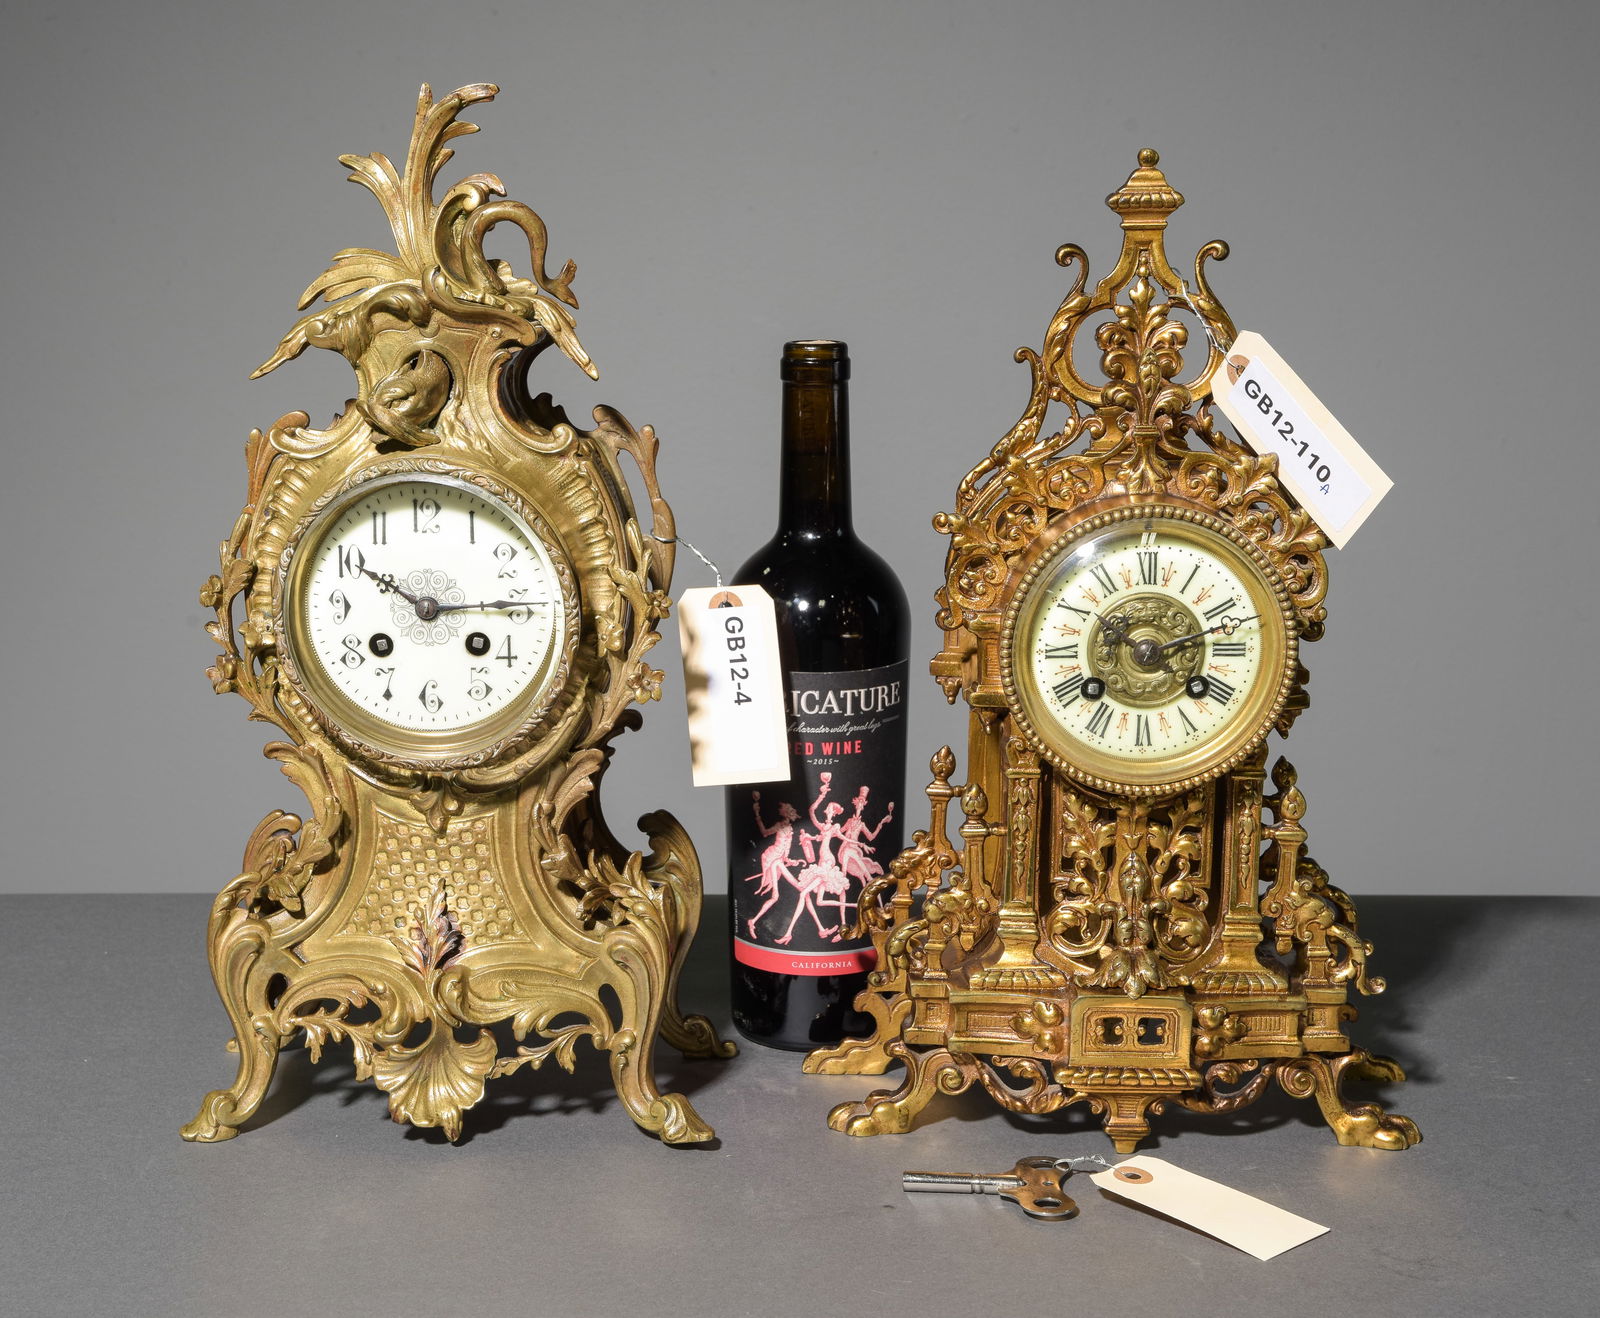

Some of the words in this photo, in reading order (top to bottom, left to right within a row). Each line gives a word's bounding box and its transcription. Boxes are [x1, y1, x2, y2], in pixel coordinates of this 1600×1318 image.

[1244, 379, 1331, 483] GB12-110
[1319, 483, 1330, 495] A
[372, 511, 387, 545] 11
[413, 497, 441, 533] 12
[468, 510, 476, 545] 1
[338, 544, 366, 579] 10
[492, 542, 518, 579] 2
[1136, 551, 1159, 586] XII
[1089, 563, 1119, 598] XI
[1179, 563, 1200, 594] I
[328, 589, 352, 625] 9
[507, 588, 535, 625] 3
[1057, 598, 1091, 622] X
[1203, 597, 1236, 621] II
[340, 633, 366, 669] 8
[495, 635, 518, 668] 4
[724, 616, 752, 706] GB12-4
[1045, 643, 1078, 659] IX
[1212, 642, 1246, 657] III
[374, 667, 395, 701] 7
[418, 680, 444, 713] 6
[467, 666, 493, 701] 5
[786, 681, 900, 717] ICATURE
[1052, 672, 1084, 709] VIII
[830, 721, 848, 733] with
[1085, 701, 1114, 739] VII
[1134, 714, 1152, 747] VI
[1178, 705, 1199, 736] V
[821, 740, 862, 755] WINE
[791, 960, 852, 969] CALIFORNIA
